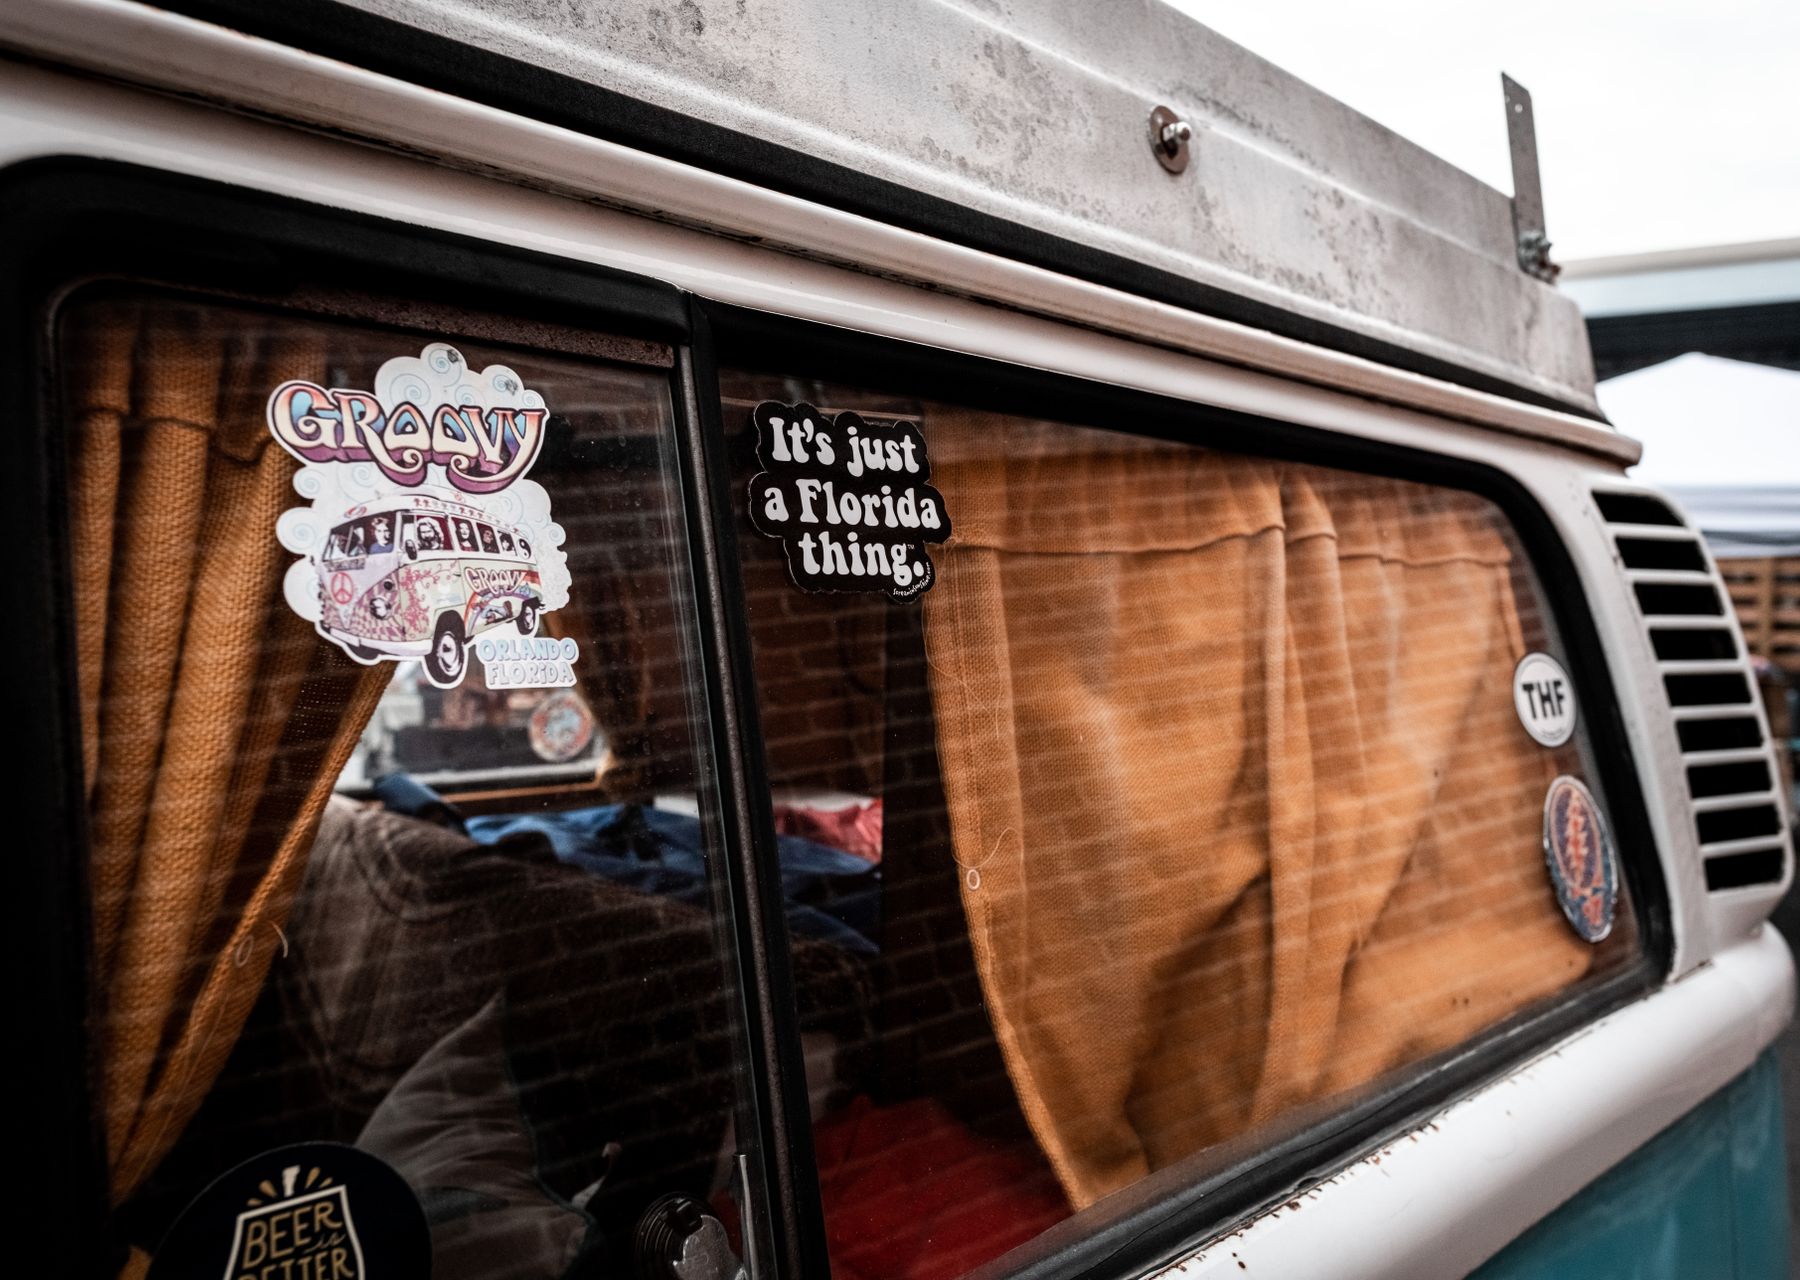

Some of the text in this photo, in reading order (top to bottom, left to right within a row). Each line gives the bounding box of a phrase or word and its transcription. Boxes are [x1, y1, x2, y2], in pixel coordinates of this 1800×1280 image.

[272, 383, 546, 494] GROOVY
[769, 417, 920, 477] It's just
[764, 478, 941, 529] a Florida
[464, 567, 527, 595] GROOVY
[480, 639, 577, 662] ORLANDO
[1521, 680, 1564, 719] THF
[243, 1201, 343, 1269] BEER
[237, 1247, 355, 1280] TTER
